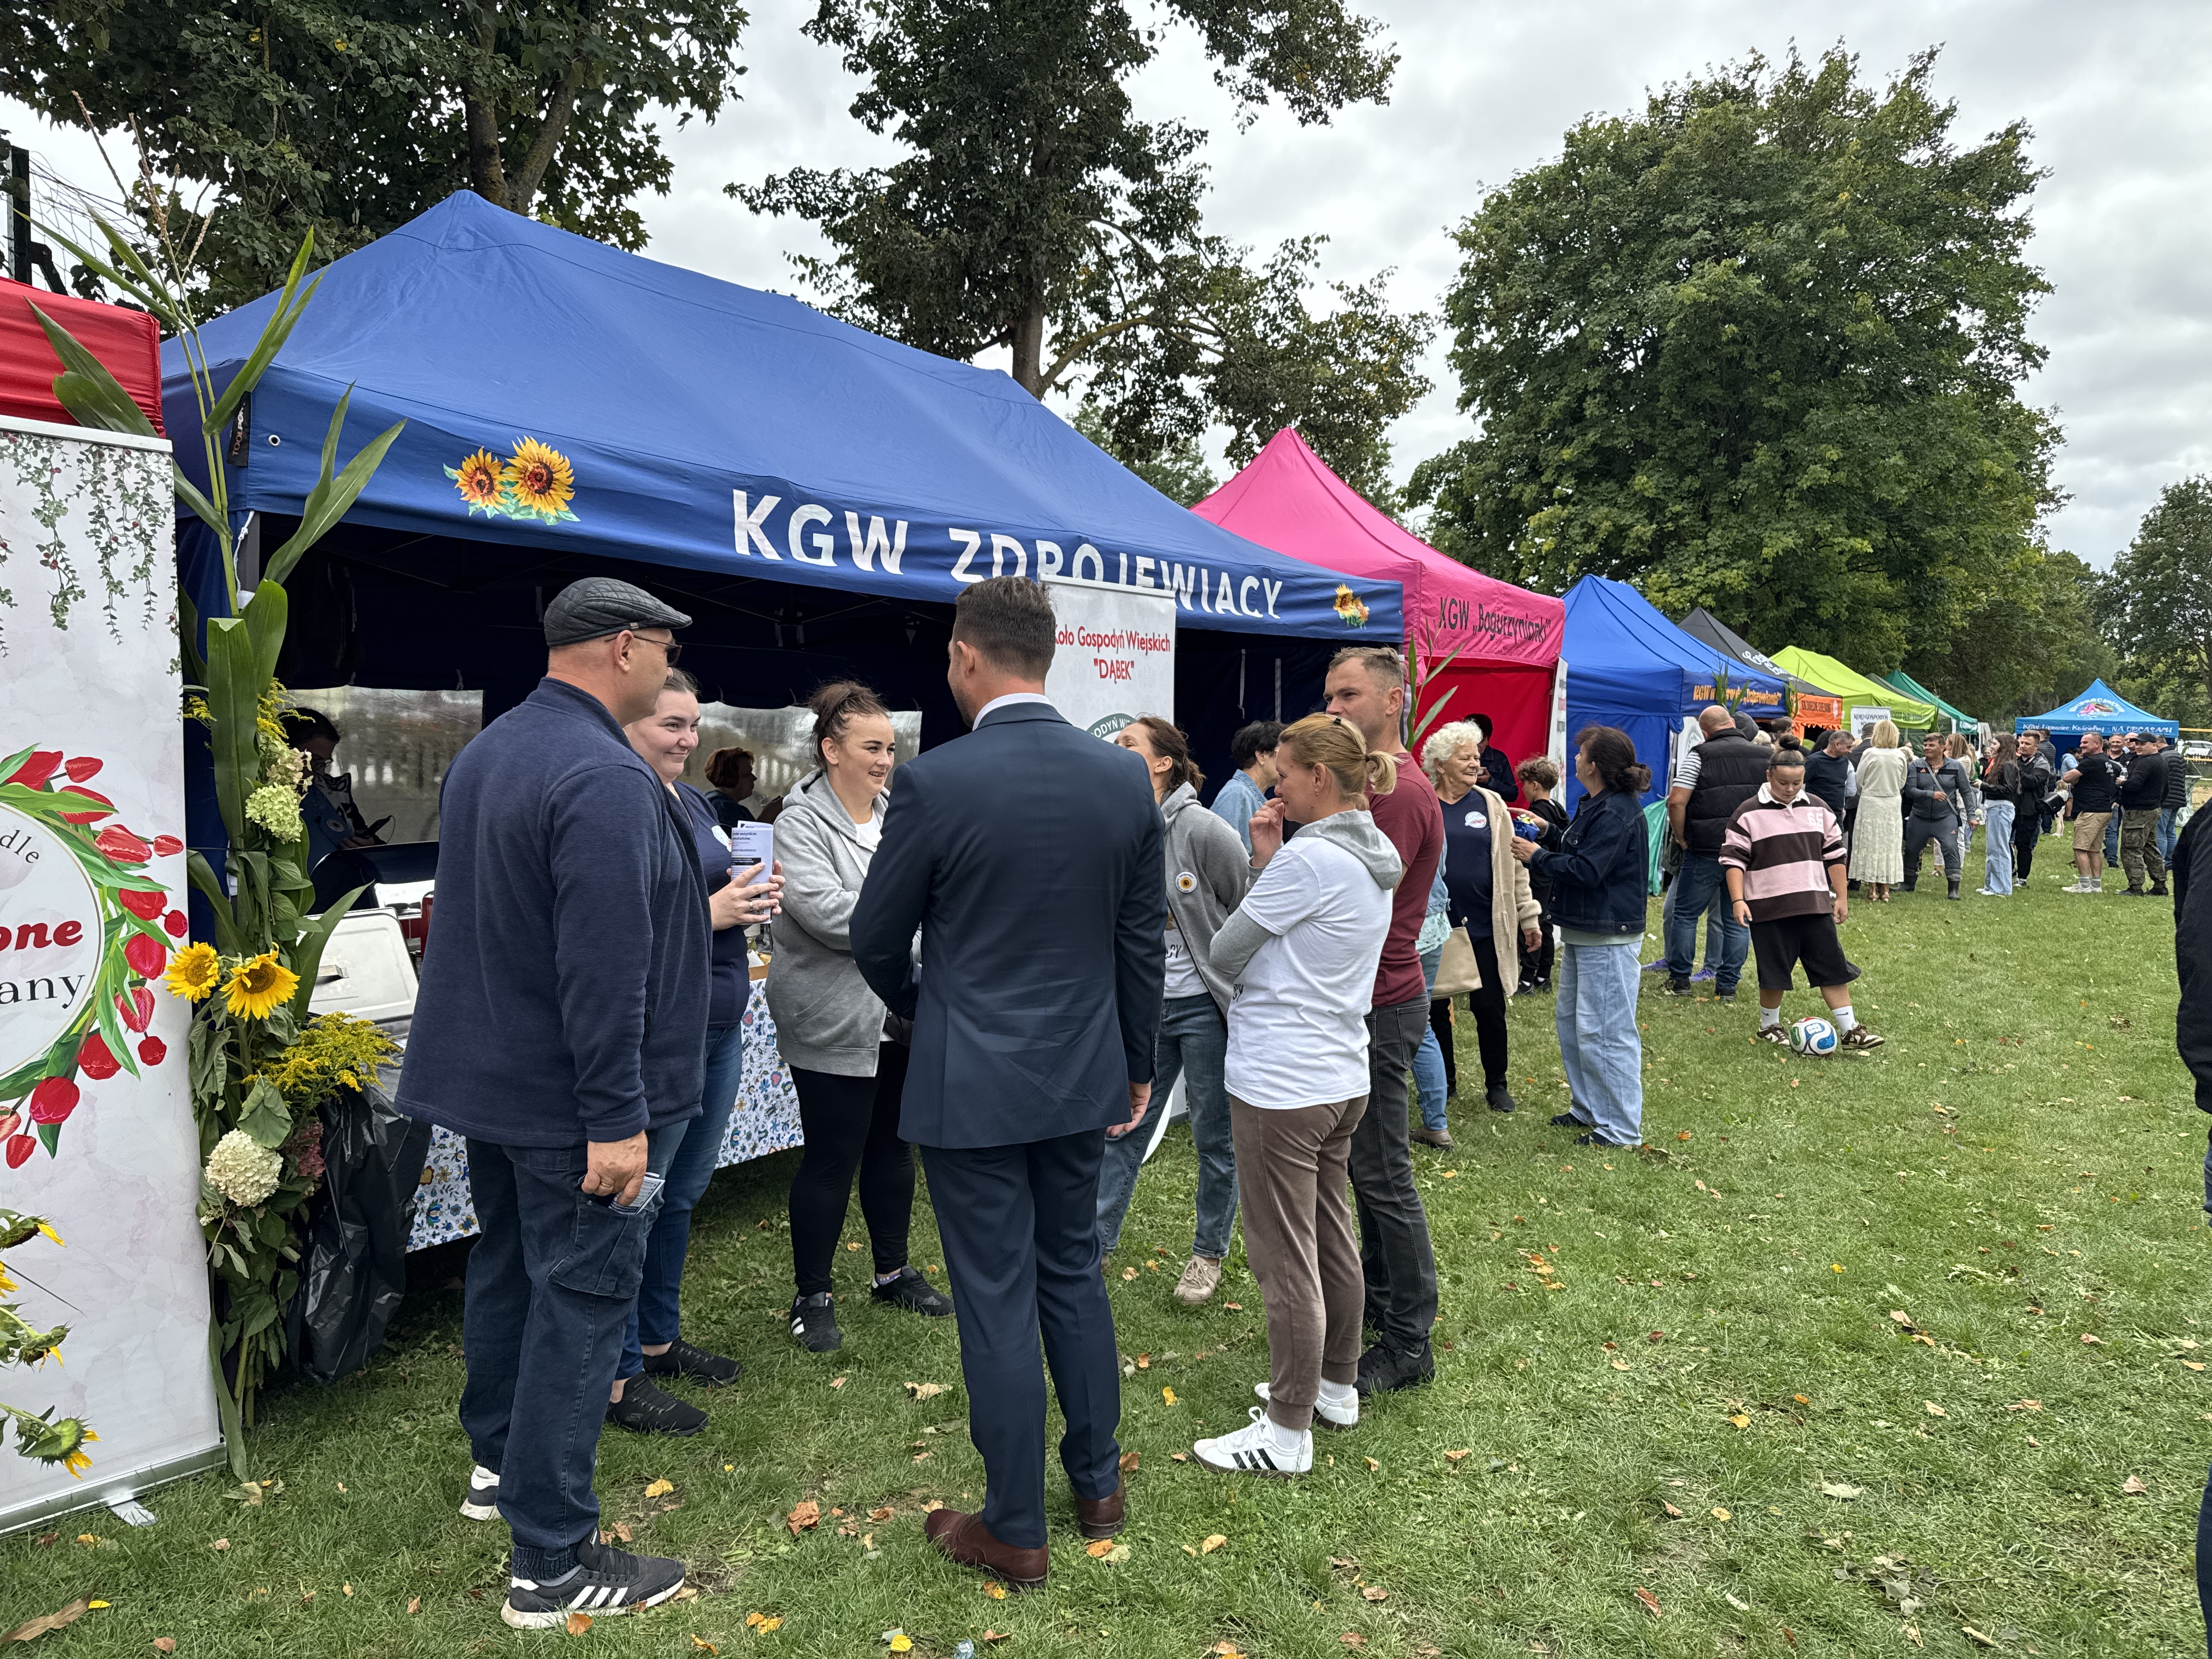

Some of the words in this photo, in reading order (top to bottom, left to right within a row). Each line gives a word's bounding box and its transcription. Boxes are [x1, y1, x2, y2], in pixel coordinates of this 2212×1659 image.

[733, 489, 909, 575] KGW
[1438, 597, 1470, 631] KGW
[1077, 625, 1125, 654] Gospodyń
[1125, 630, 1171, 656] Wiejskich
[1093, 658, 1135, 684] "DĄBEK"
[1693, 685, 1711, 701] KGW
[1091, 716, 1118, 738] ODYŃ
[0, 974, 86, 1009] any
